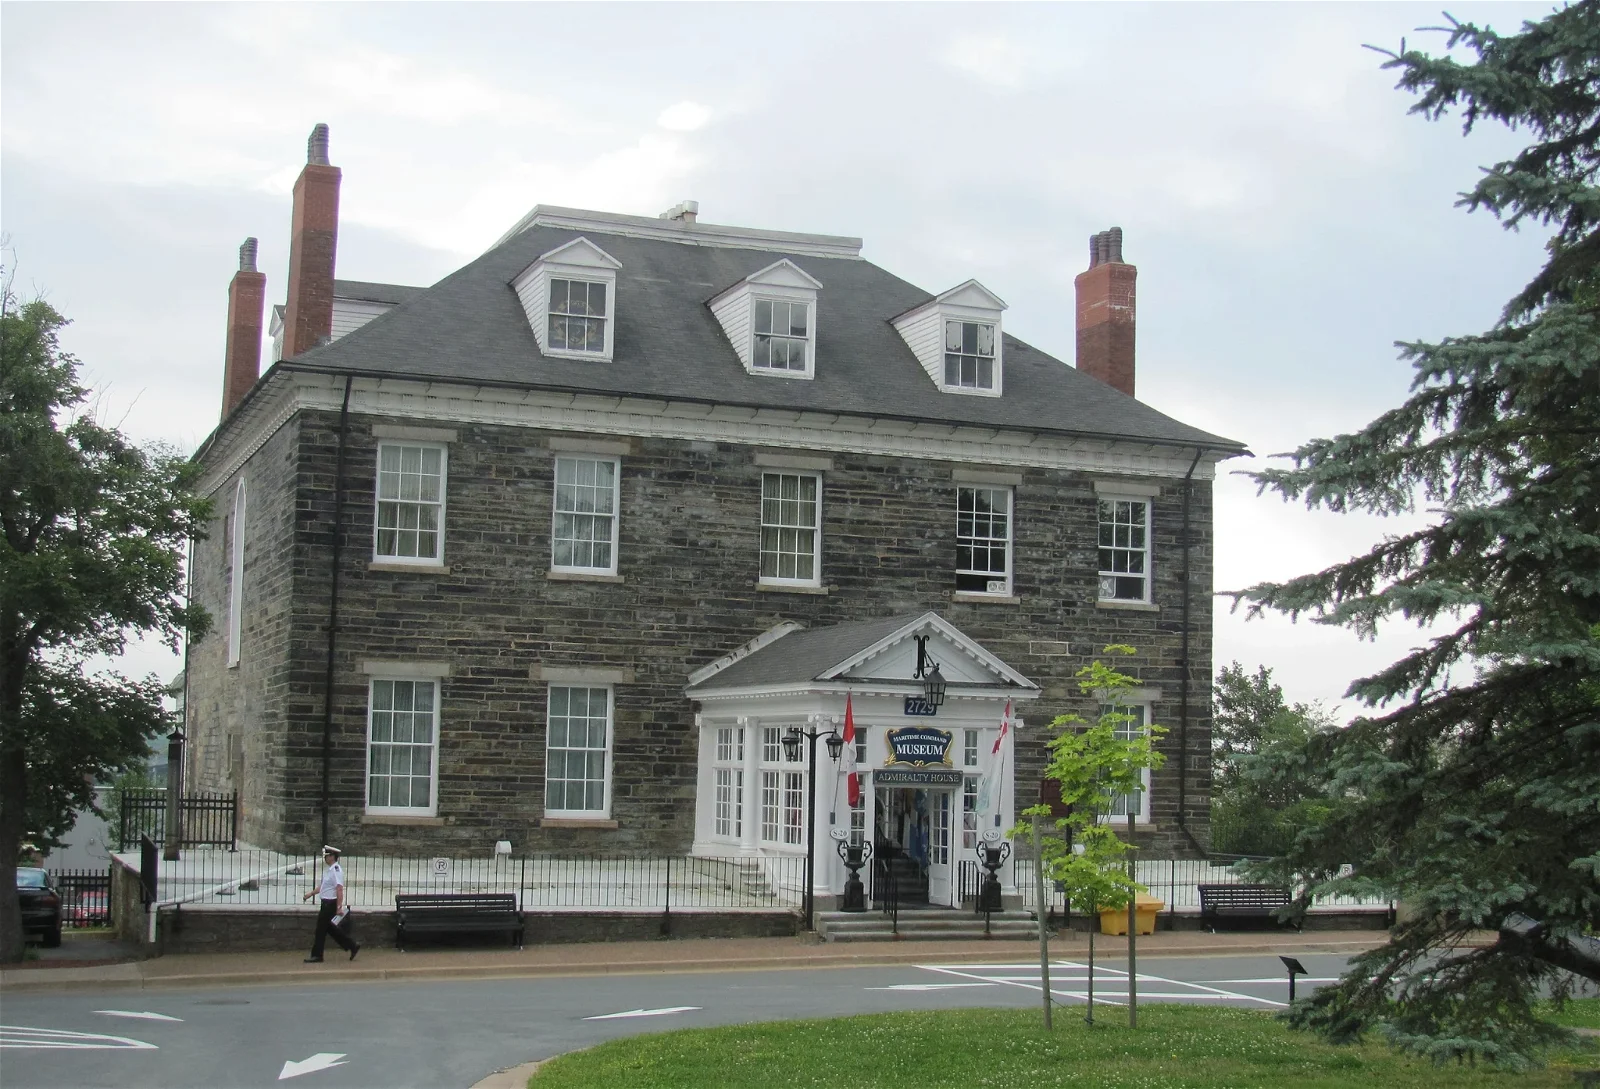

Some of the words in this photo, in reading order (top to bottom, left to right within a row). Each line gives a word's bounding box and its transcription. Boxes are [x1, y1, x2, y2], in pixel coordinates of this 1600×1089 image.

[893, 734, 920, 743] MARITIME
[920, 734, 947, 743] COMMAND
[896, 743, 944, 755] MUSEUM
[878, 772, 929, 782] ADMIRALTY
[930, 773, 959, 782] HOUSE
